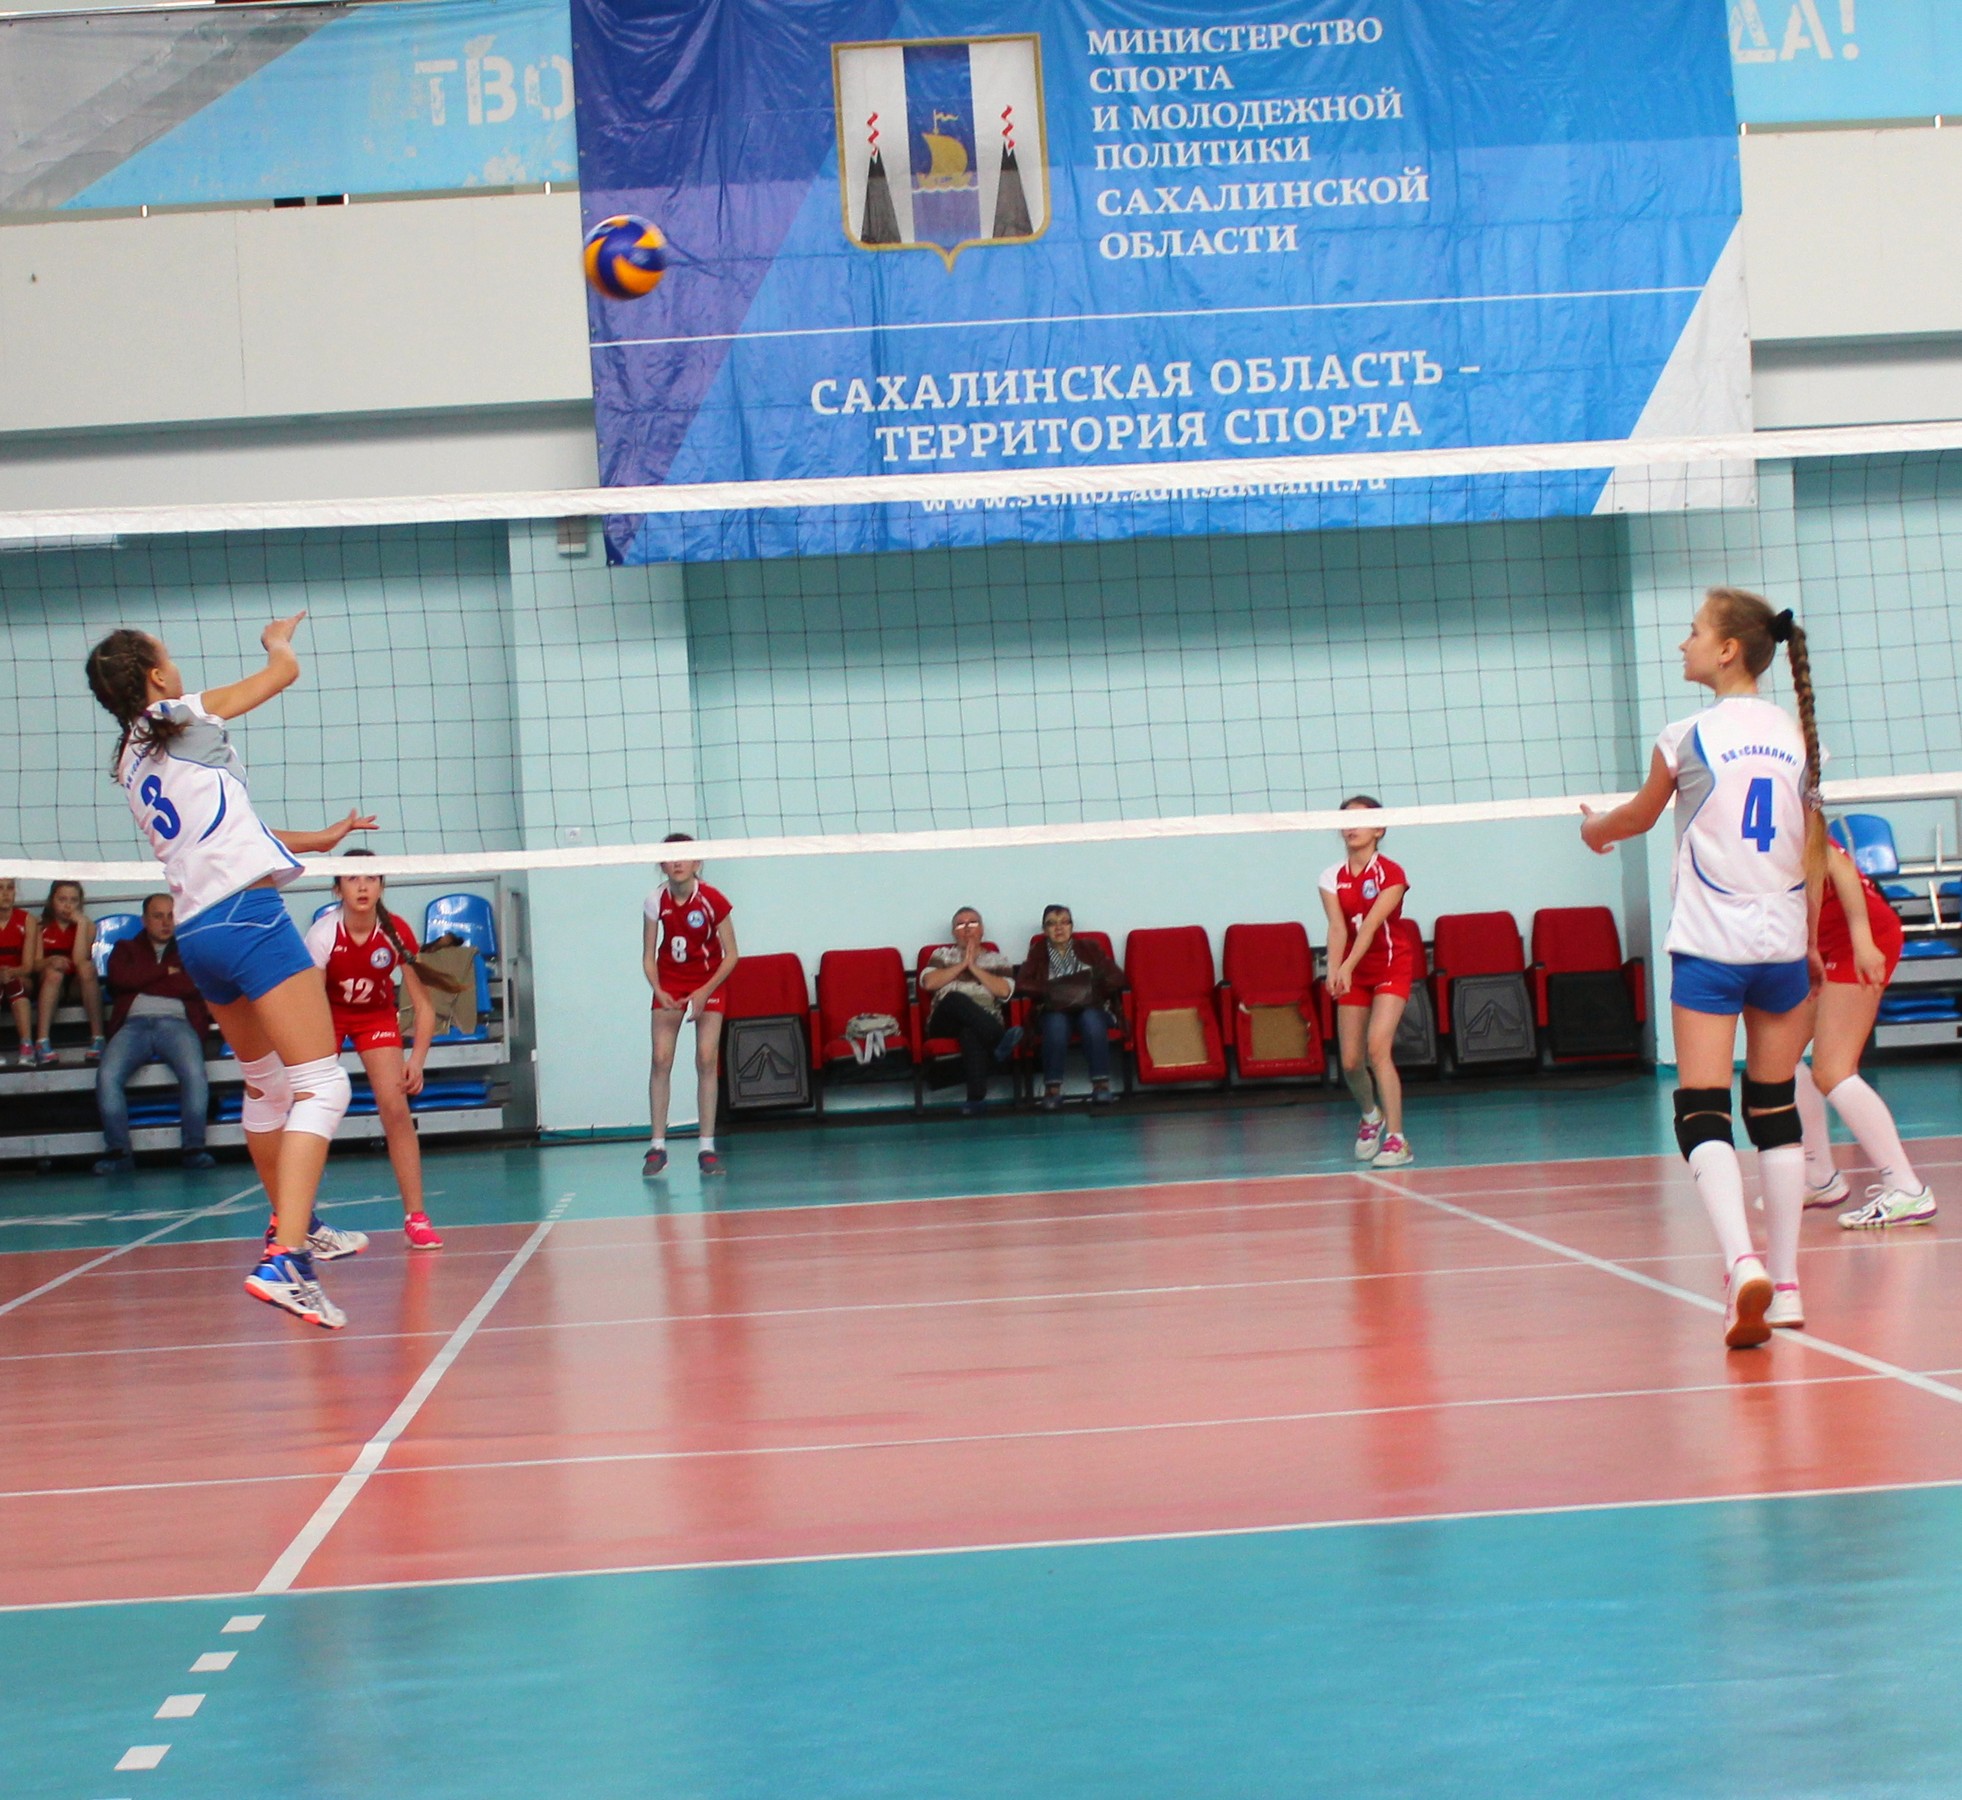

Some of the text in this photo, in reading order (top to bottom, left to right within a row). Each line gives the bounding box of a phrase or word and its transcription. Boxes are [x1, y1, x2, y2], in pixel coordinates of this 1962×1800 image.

[1087, 17, 1383, 55] МИНИСТЕРСТВО
[1089, 65, 1234, 94] СПОРТА
[1092, 86, 1404, 132] И МОЛОДЕЖНОЙ
[1094, 136, 1312, 171] ПОЛИТИКИ
[1096, 166, 1430, 217] САХАЛИНСКОЙ
[1099, 224, 1298, 260] ОБЛАСТИ
[810, 360, 1193, 415] САХАЛИНСКАЯ
[1210, 350, 1443, 395] ОБЛАСТЬ
[874, 401, 1422, 462] ТЕРРИТОРИЯ СПОРТА
[140, 774, 181, 840] 3
[1742, 777, 1776, 852] 4
[671, 936, 687, 963] 8
[338, 977, 375, 1004] 12
